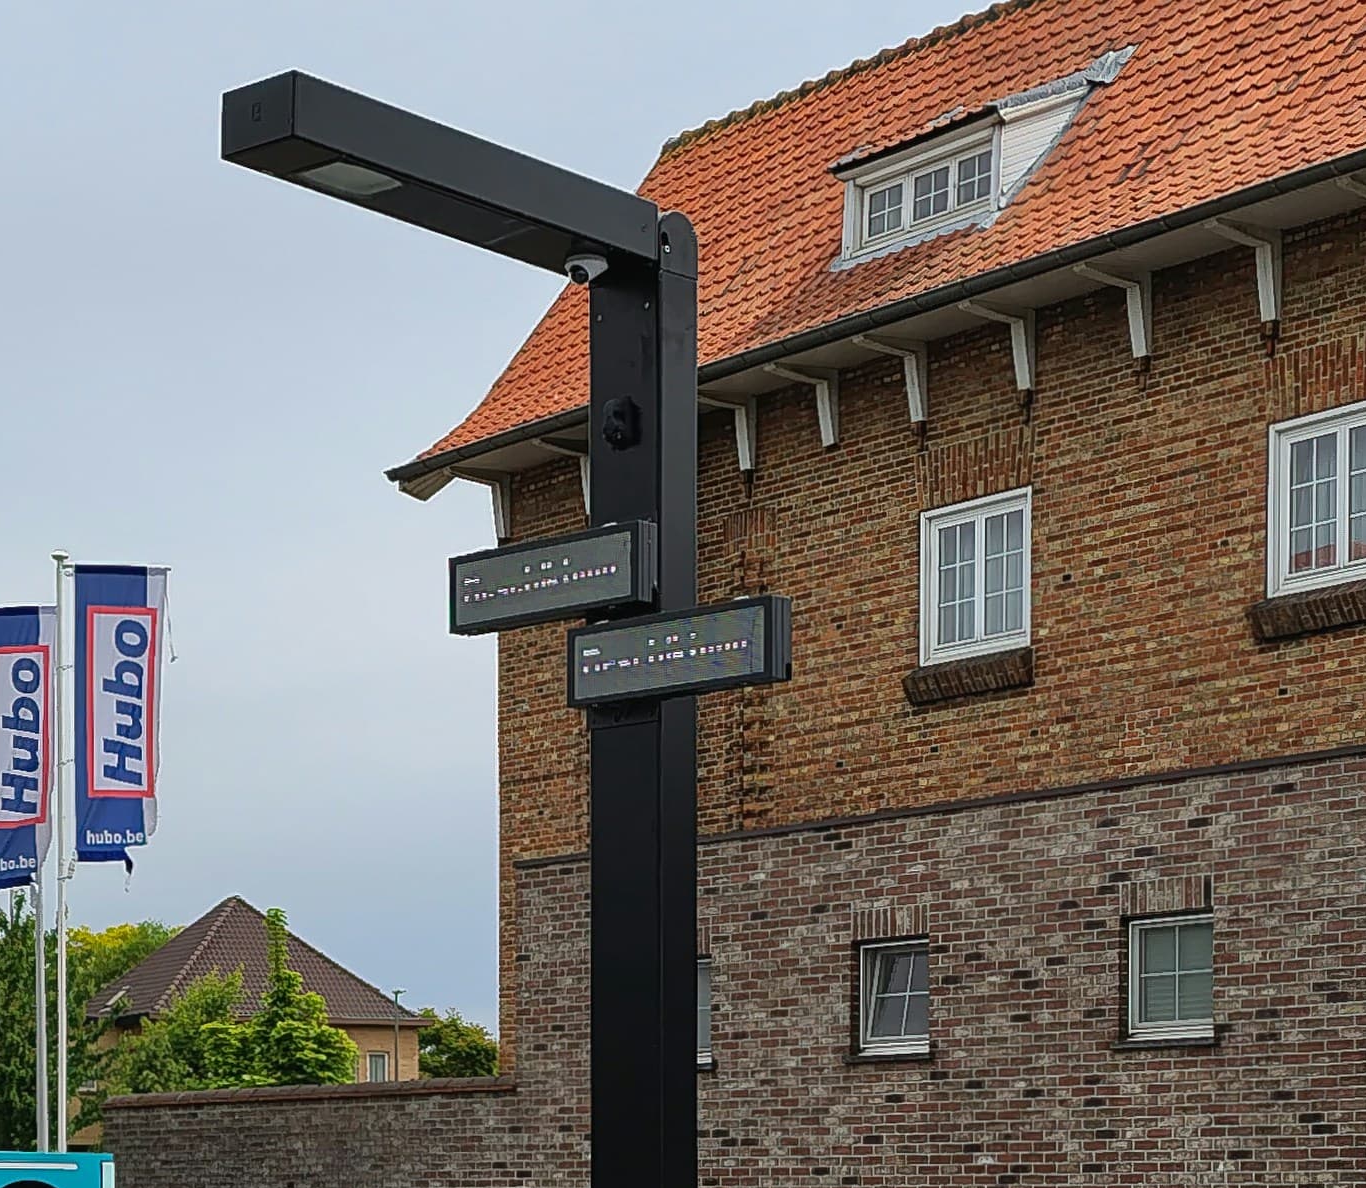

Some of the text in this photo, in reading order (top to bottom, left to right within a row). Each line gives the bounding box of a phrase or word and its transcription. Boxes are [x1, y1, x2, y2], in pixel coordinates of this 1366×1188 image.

[2, 657, 41, 814] Hubo
[103, 619, 148, 786] Hubo
[85, 829, 144, 845] hubo.be
